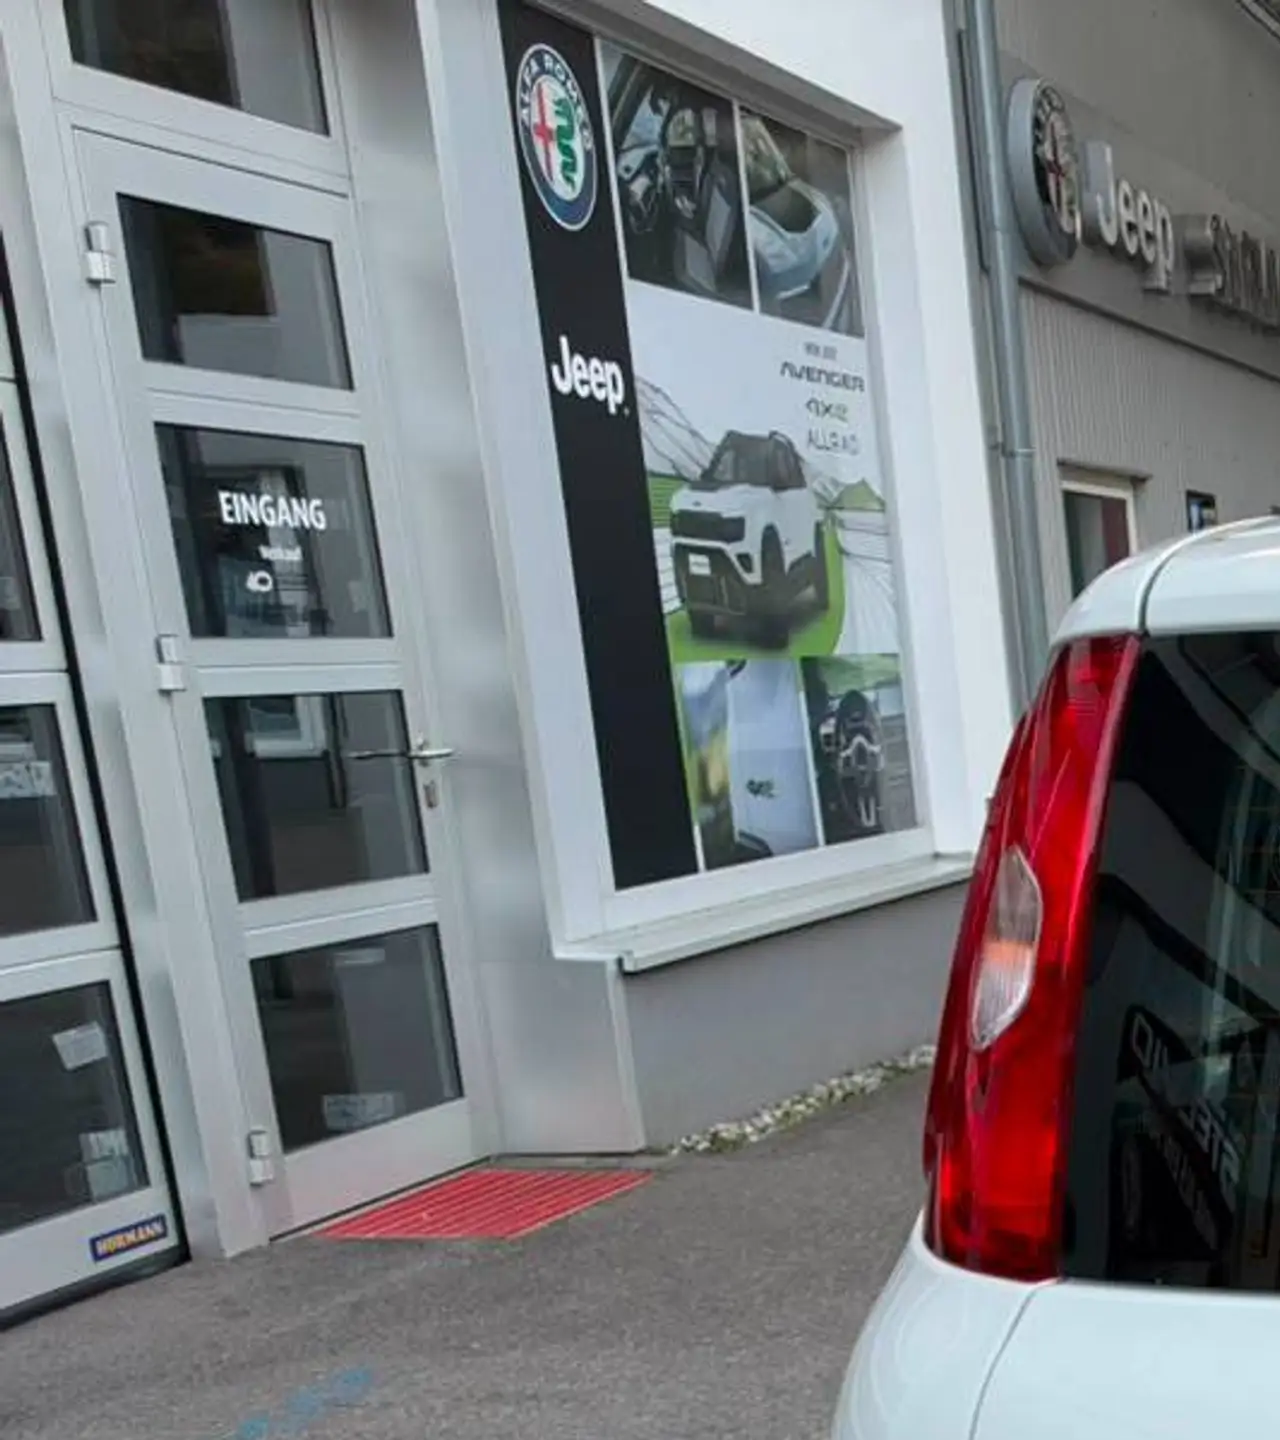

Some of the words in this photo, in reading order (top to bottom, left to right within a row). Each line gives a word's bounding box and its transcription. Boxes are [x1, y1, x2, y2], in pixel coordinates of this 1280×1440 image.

[1090, 144, 1175, 292] Jeep
[551, 335, 625, 415] Jeep
[218, 490, 327, 530] EINGANG
